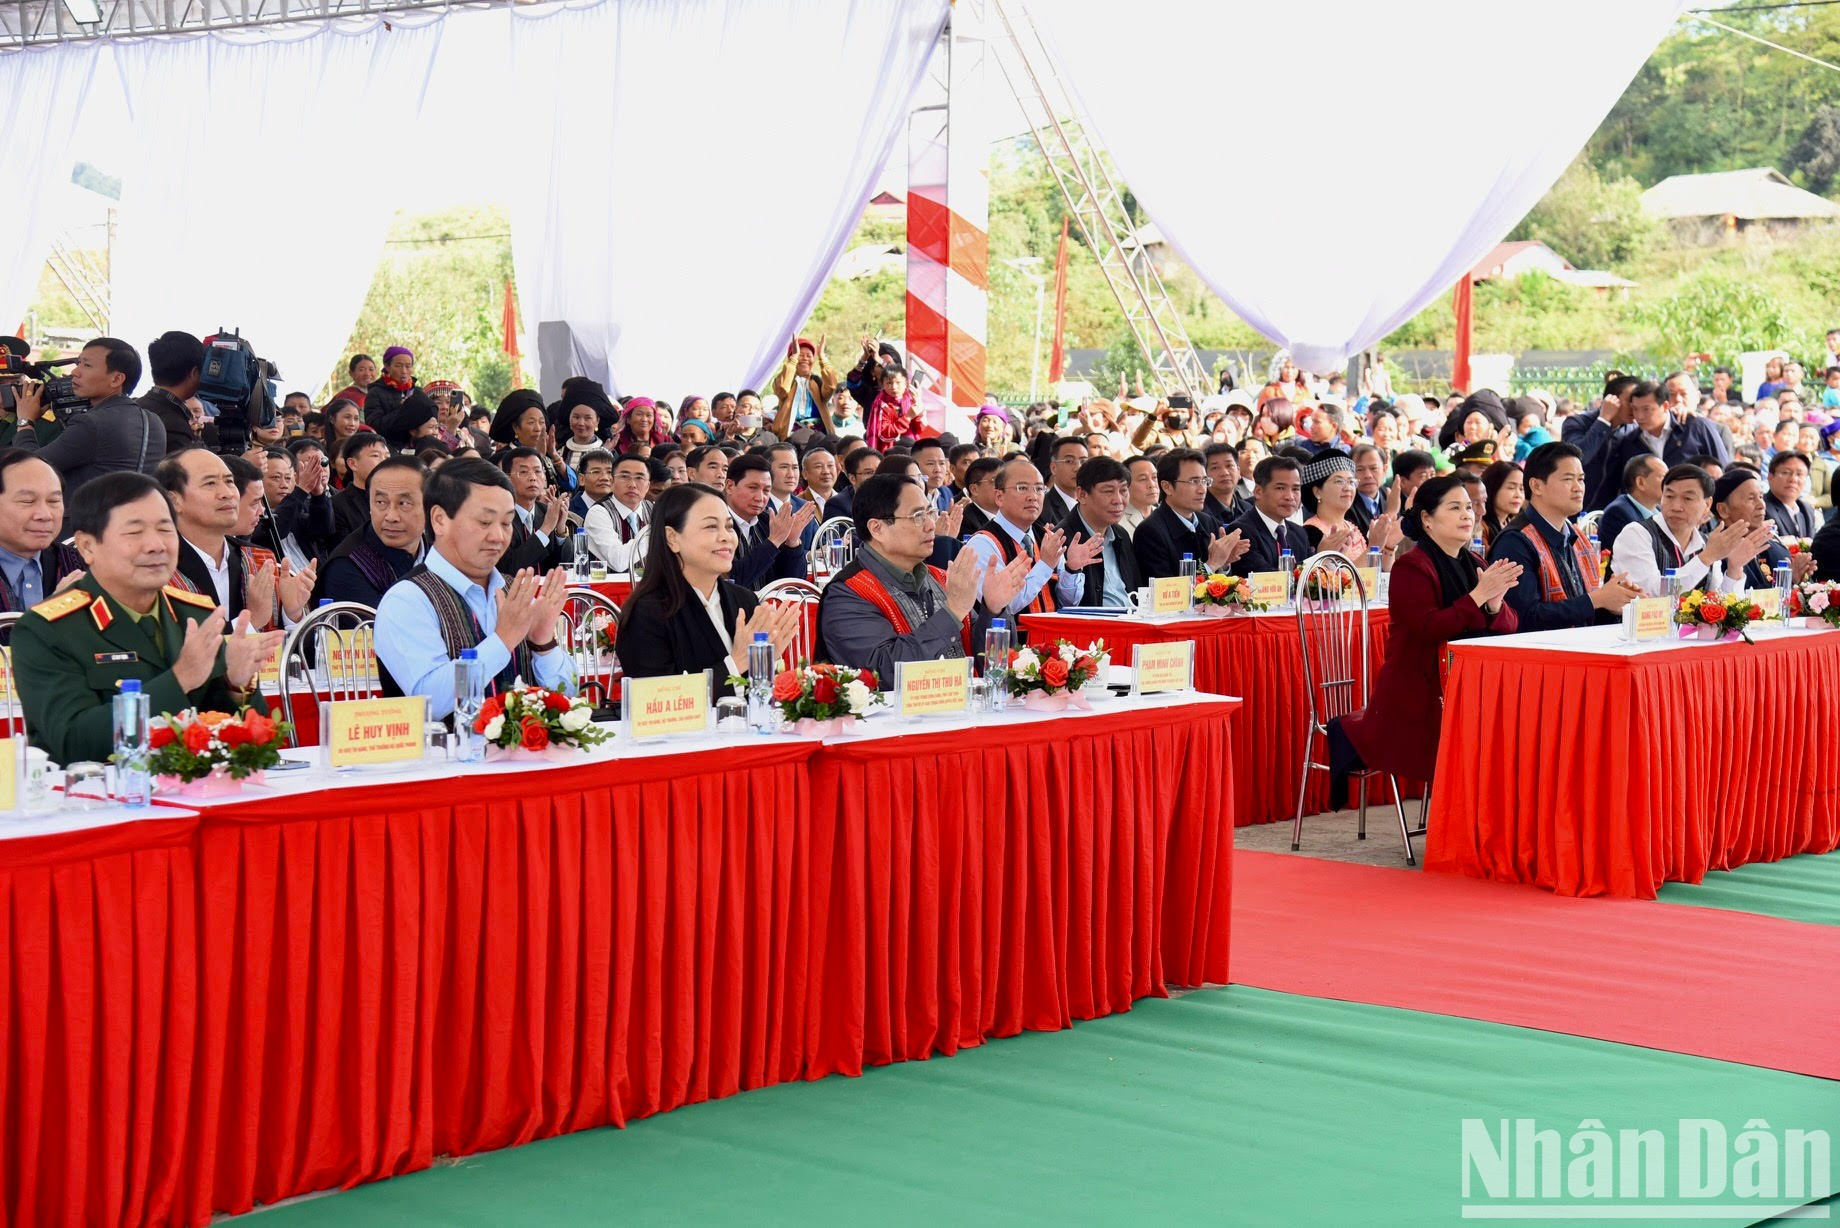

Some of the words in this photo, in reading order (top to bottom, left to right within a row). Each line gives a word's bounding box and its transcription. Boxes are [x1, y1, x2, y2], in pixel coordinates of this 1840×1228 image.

[665, 700, 671, 713] A
[363, 724, 383, 739] HUY
[386, 722, 410, 740] VỊNH
